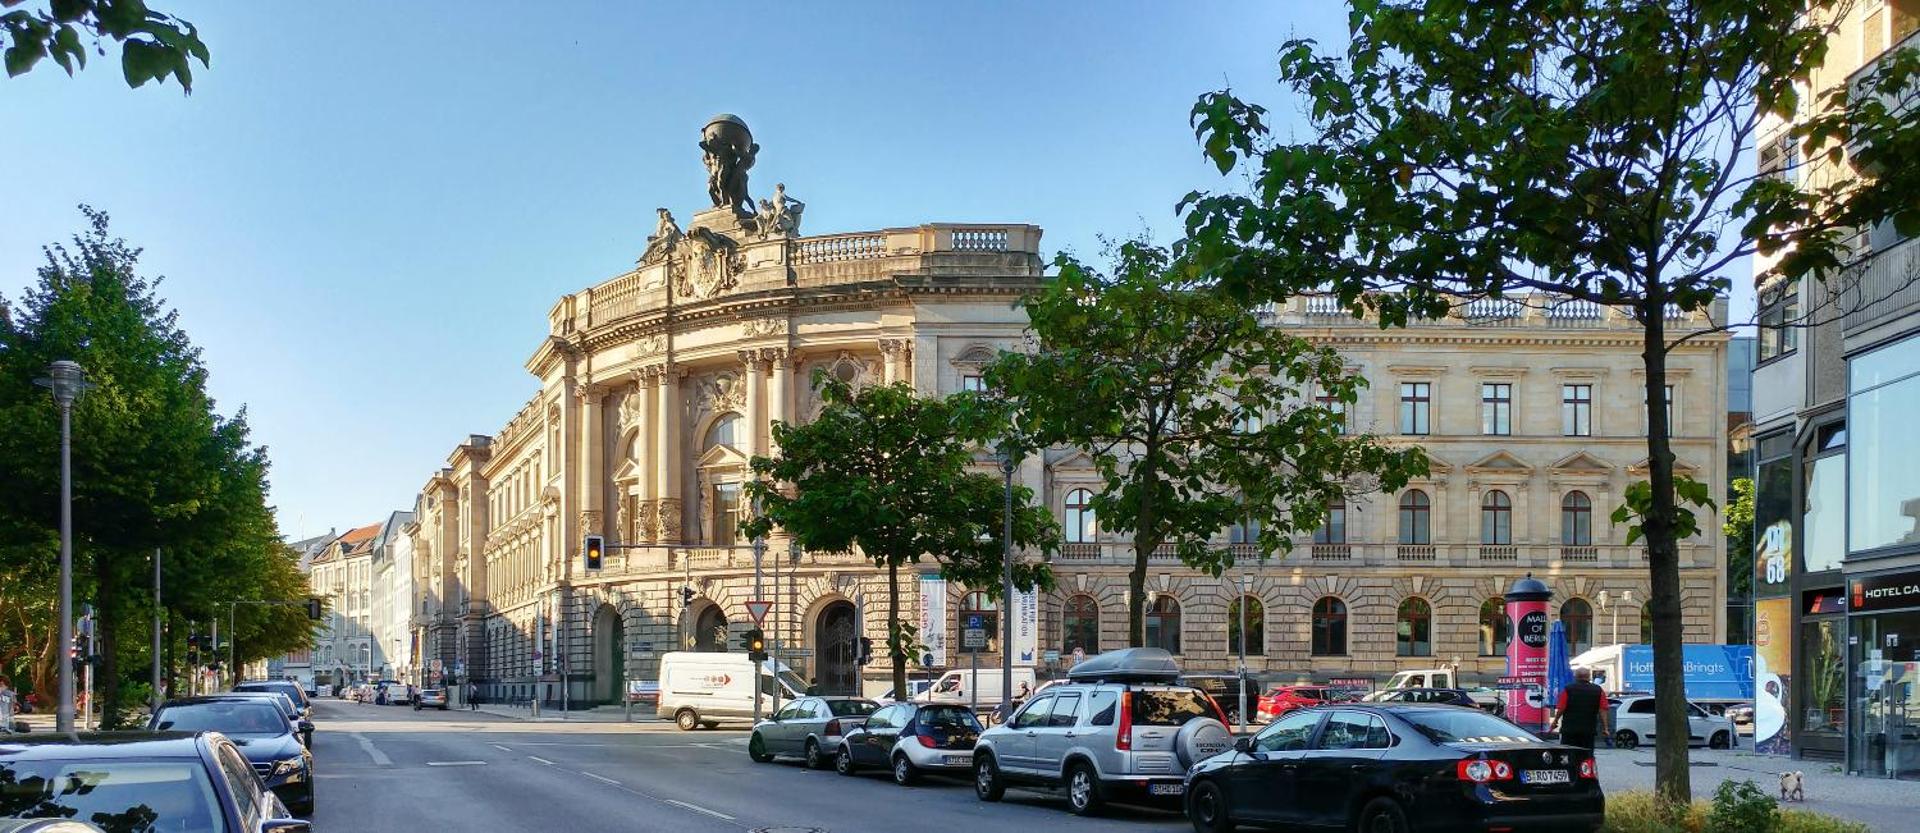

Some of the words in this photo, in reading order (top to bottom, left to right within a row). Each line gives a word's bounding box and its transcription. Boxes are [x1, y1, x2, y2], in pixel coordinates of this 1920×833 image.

[1766, 555, 1785, 584] 68
[1865, 587, 1901, 598] HOTEL
[1531, 625, 1543, 633] OF
[1524, 635, 1547, 643] BERLIN
